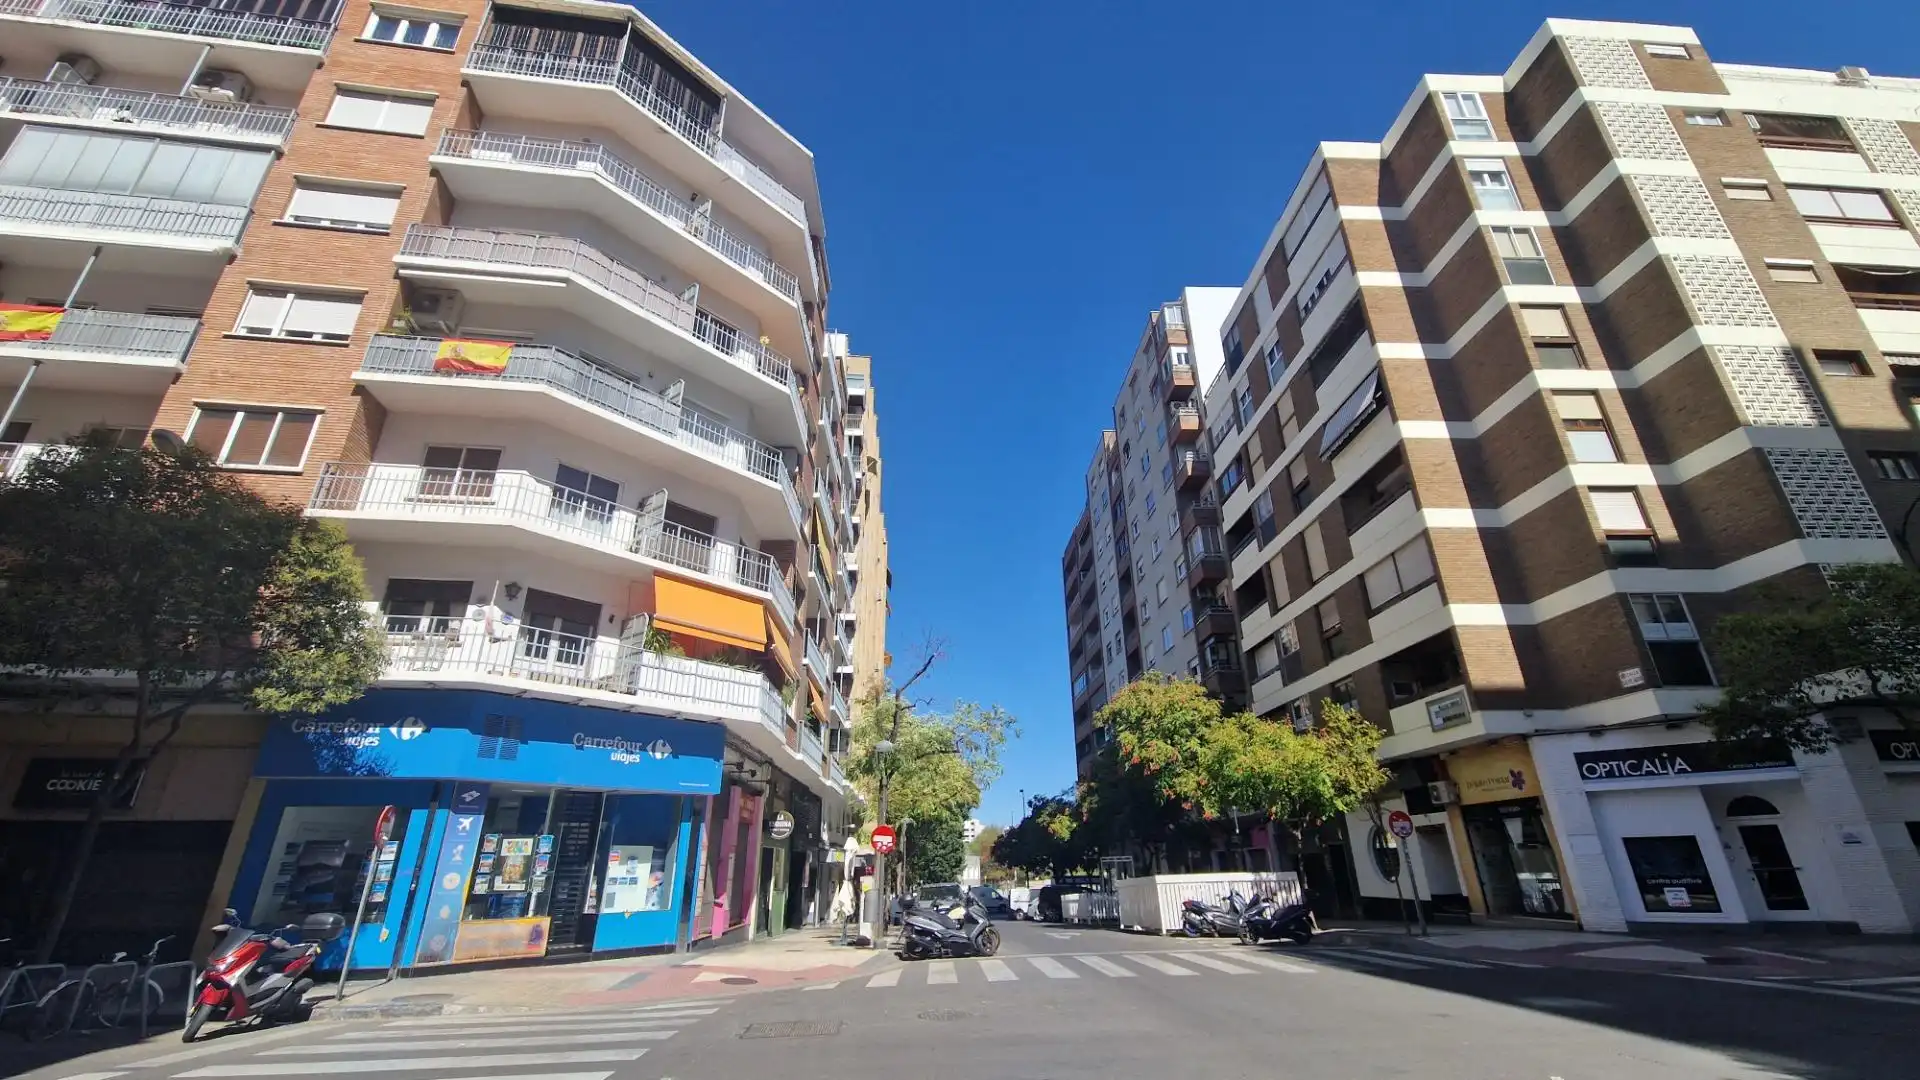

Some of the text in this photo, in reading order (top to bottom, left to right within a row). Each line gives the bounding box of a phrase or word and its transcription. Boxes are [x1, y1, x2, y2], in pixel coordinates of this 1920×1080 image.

[291, 717, 385, 734] Carrefour
[572, 732, 643, 753] Carrefour
[46, 778, 103, 791] COOKIE
